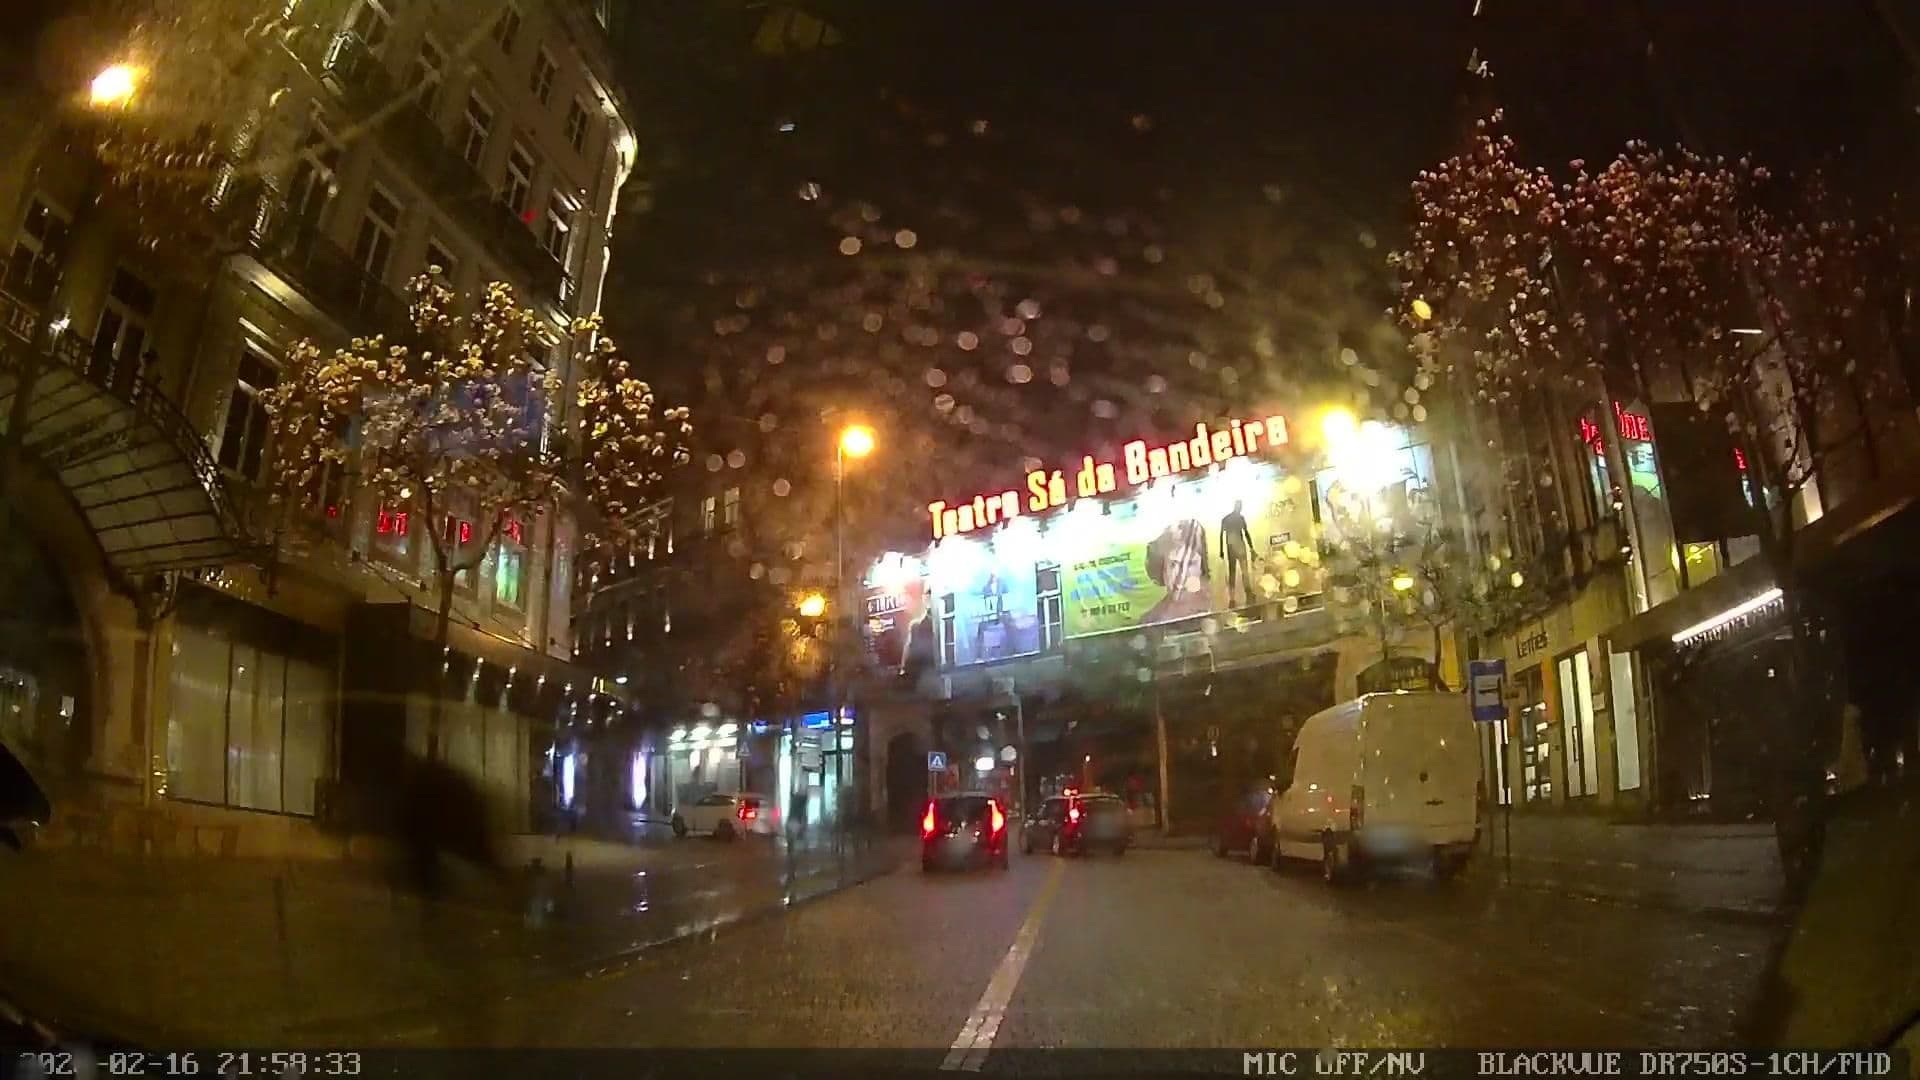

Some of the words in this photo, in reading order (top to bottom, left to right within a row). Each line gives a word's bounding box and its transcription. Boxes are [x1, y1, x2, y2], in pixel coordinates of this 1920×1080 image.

[928, 490, 1020, 539] Teatro
[1027, 469, 1067, 512] Sá
[1077, 455, 1116, 498] da
[1124, 415, 1289, 485] Bandeira
